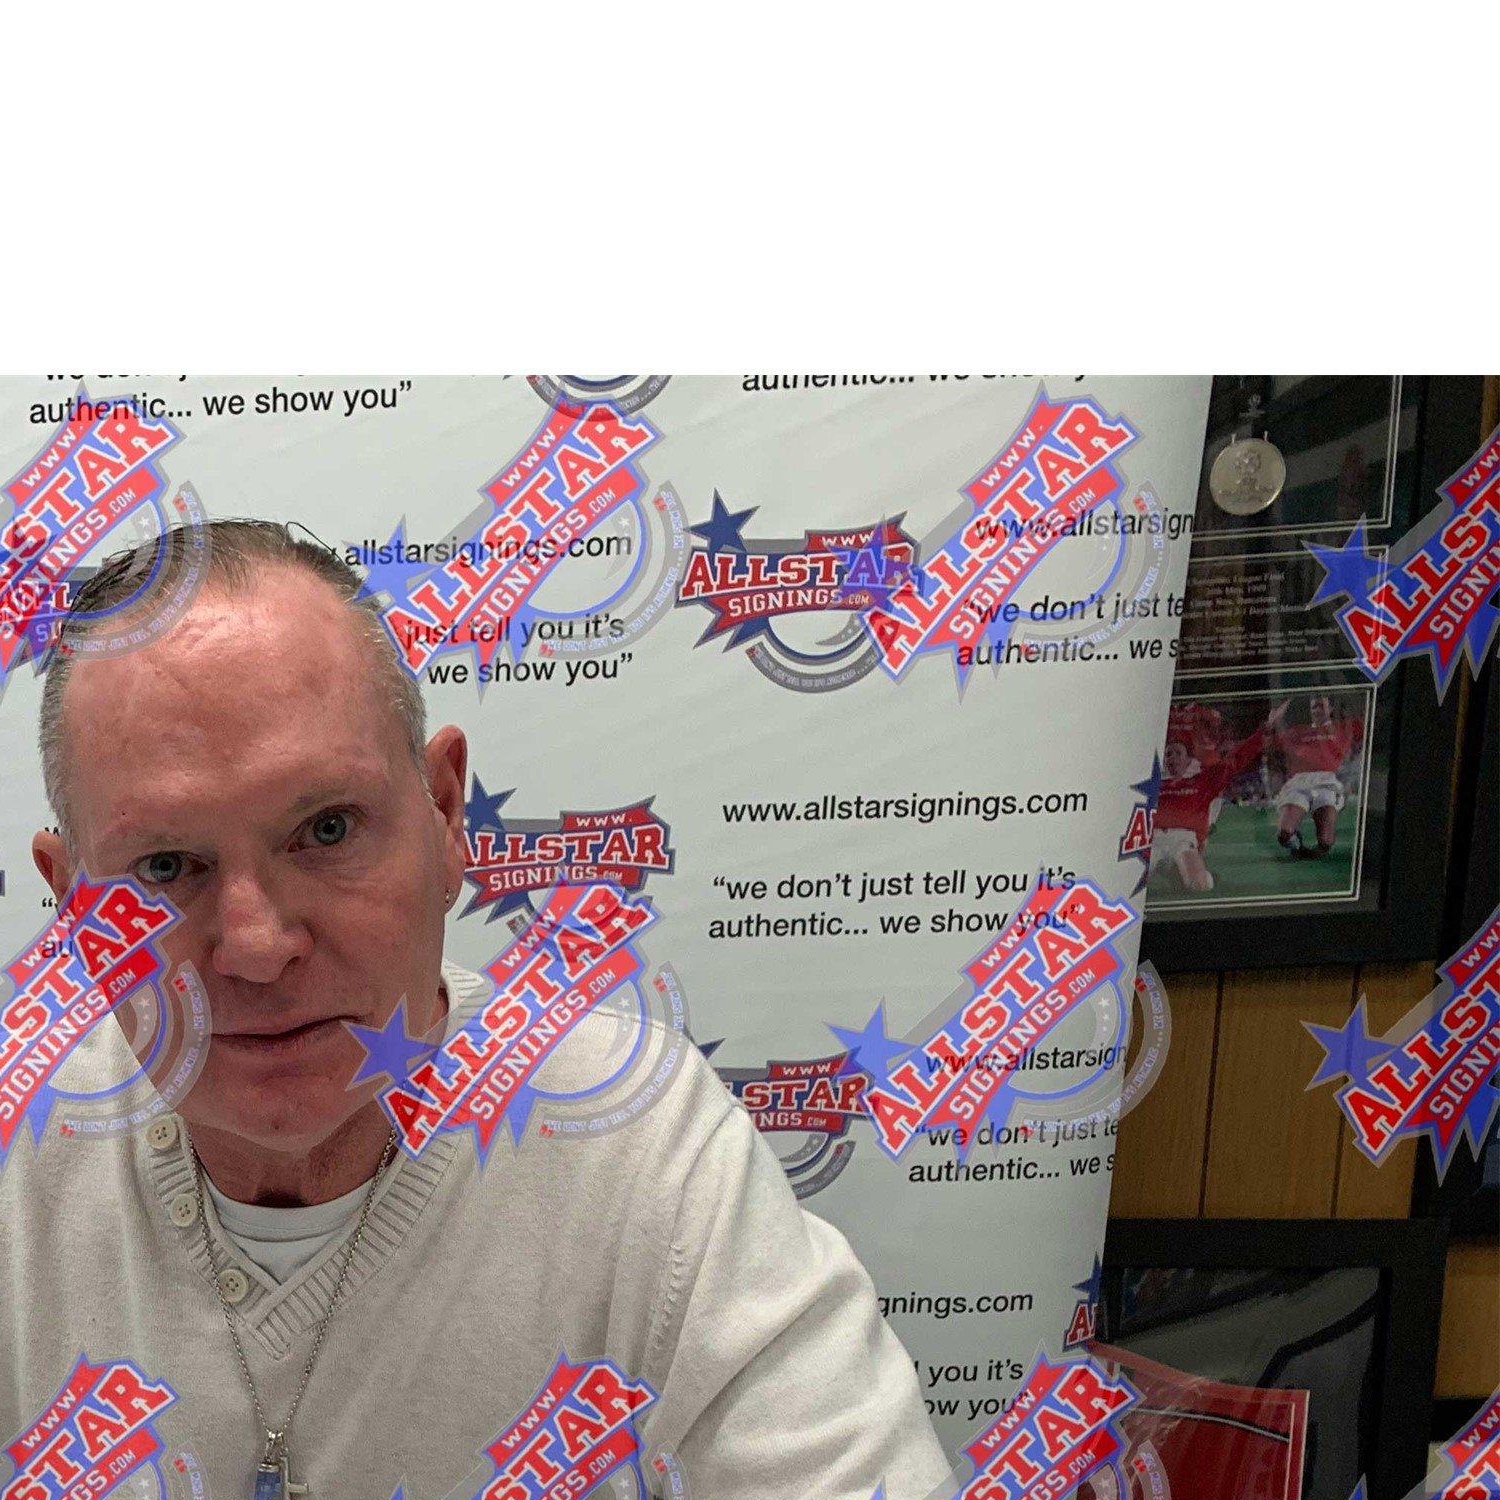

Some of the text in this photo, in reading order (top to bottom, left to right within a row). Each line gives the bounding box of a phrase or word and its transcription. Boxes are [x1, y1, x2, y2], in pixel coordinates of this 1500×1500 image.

[29, 381, 411, 426] authentic... we show you”
[427, 653, 632, 686] we show you”
[723, 791, 1087, 823] www.allstarsignings.com
[714, 864, 1077, 903] “we don’t just tell you it’s
[709, 912, 867, 938] authentic...
[880, 915, 921, 934] we
[930, 907, 1010, 936] show
